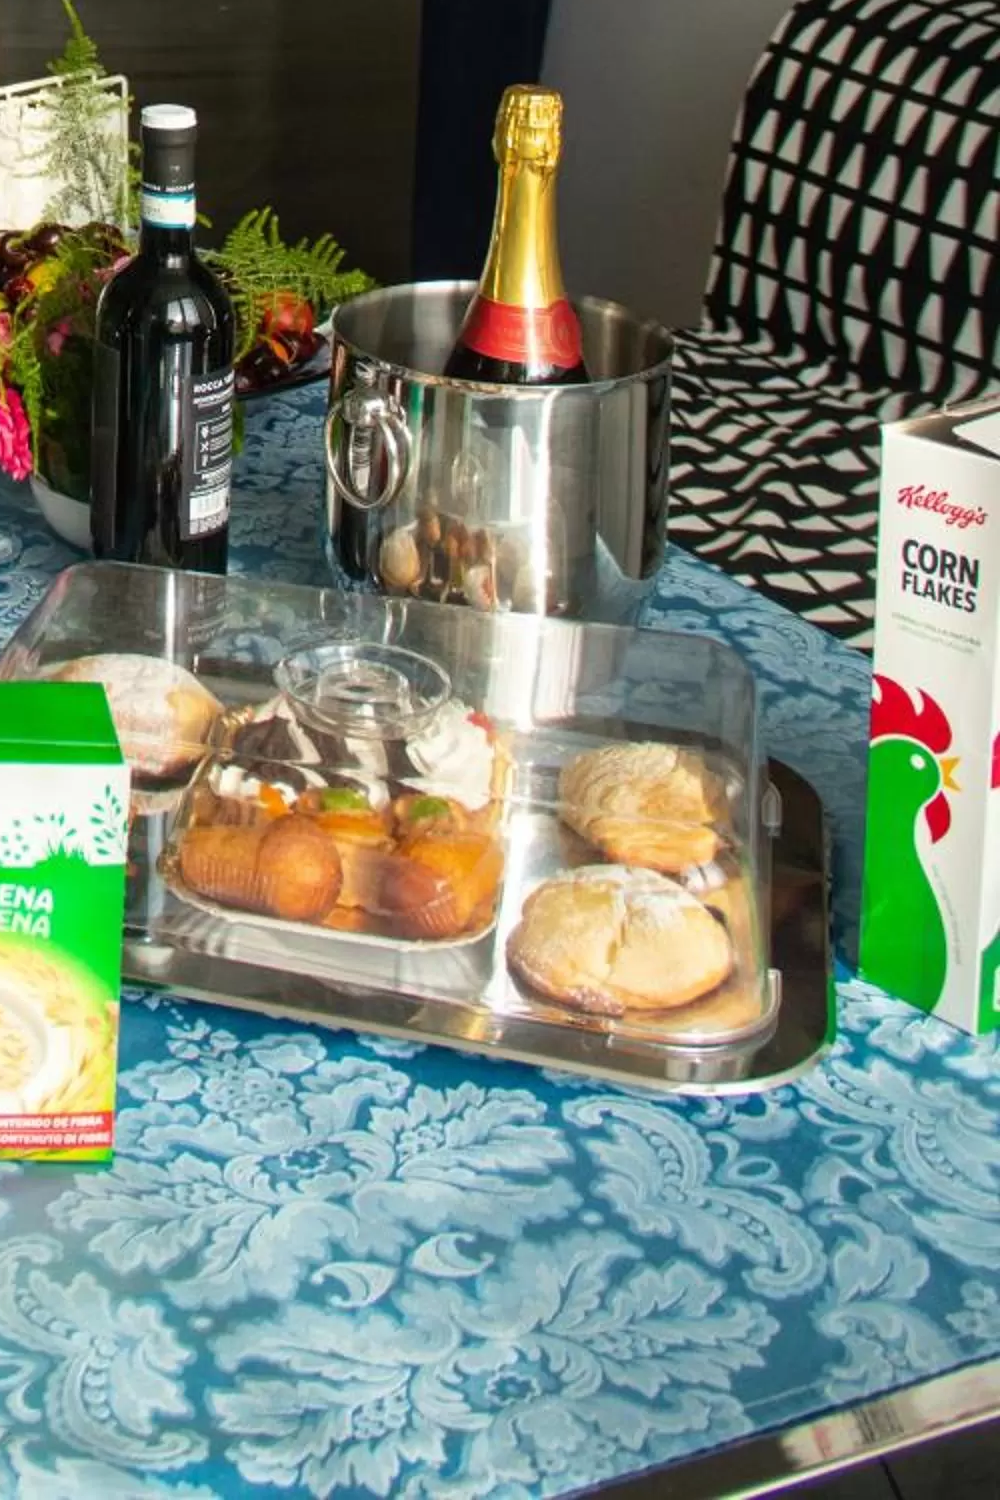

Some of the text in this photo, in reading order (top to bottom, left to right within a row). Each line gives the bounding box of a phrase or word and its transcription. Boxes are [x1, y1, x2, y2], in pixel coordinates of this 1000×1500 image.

[897, 484, 988, 529] Kellogg's
[902, 539, 979, 590] CORN
[901, 571, 977, 613] FLAKES
